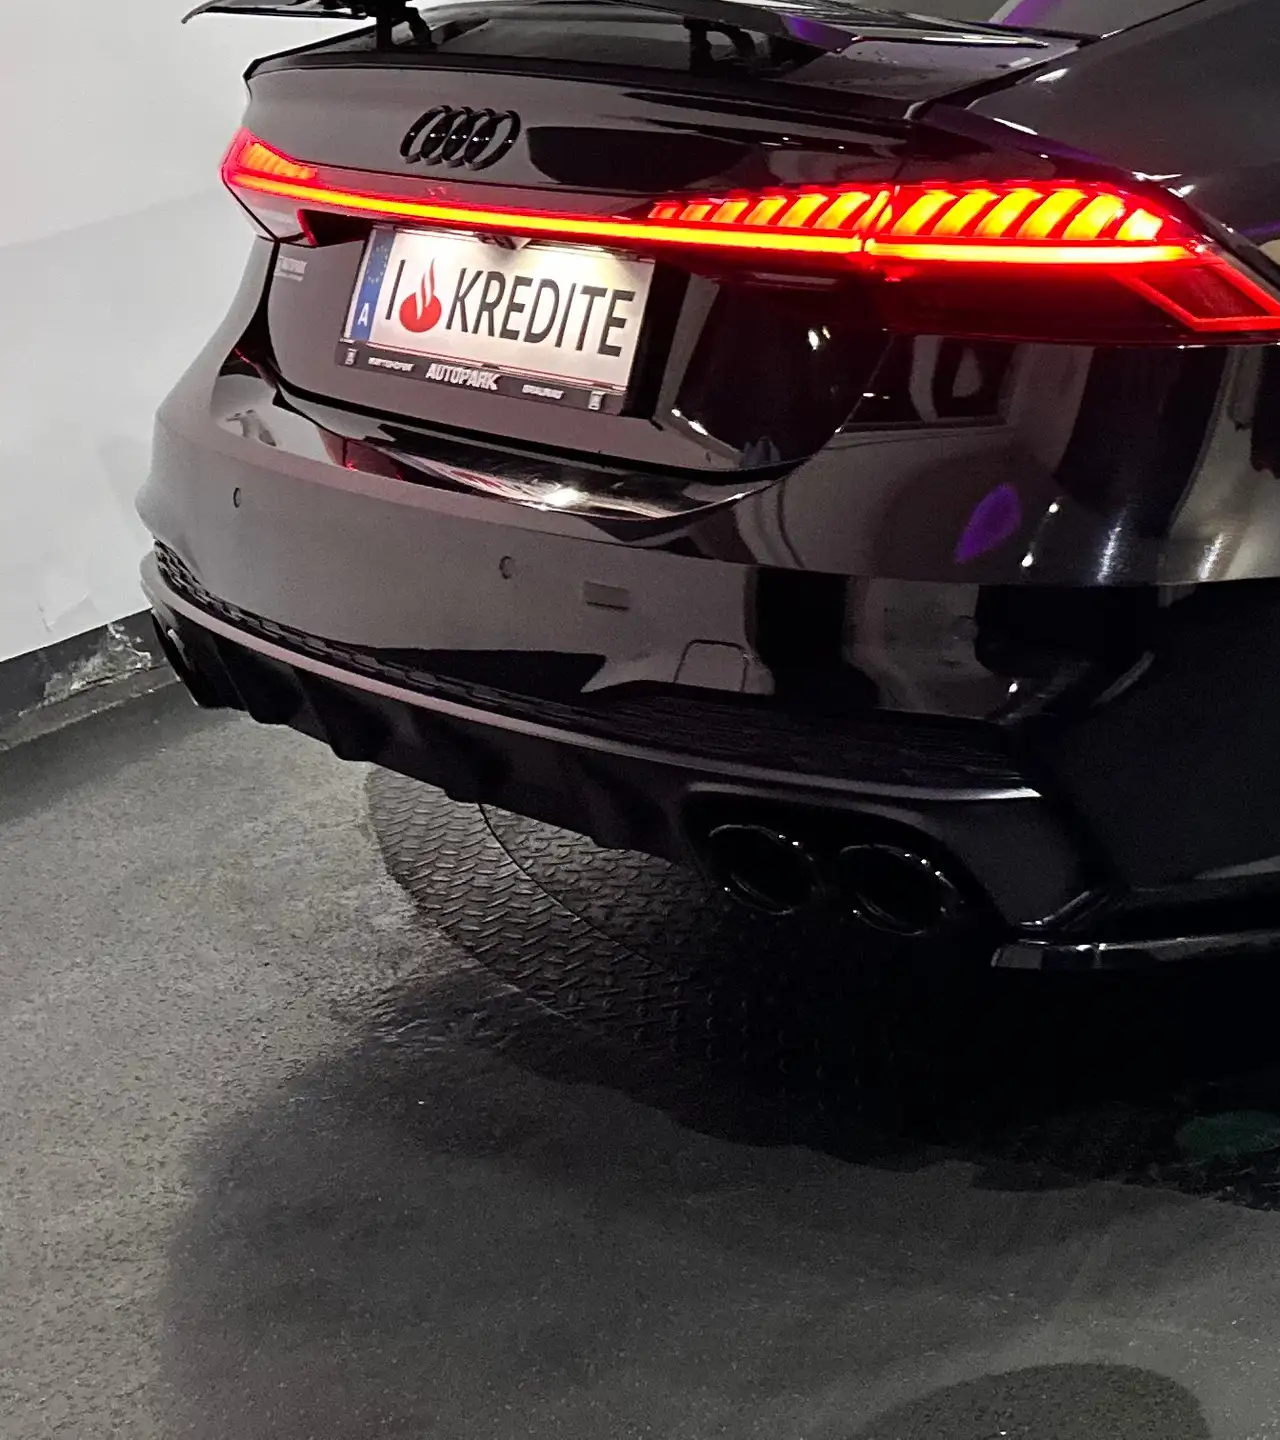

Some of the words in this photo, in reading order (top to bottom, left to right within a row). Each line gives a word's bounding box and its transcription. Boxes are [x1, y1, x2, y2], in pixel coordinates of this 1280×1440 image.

[357, 302, 370, 327] A
[446, 266, 636, 358] KREDITE
[425, 362, 500, 391] AUTOPARK
